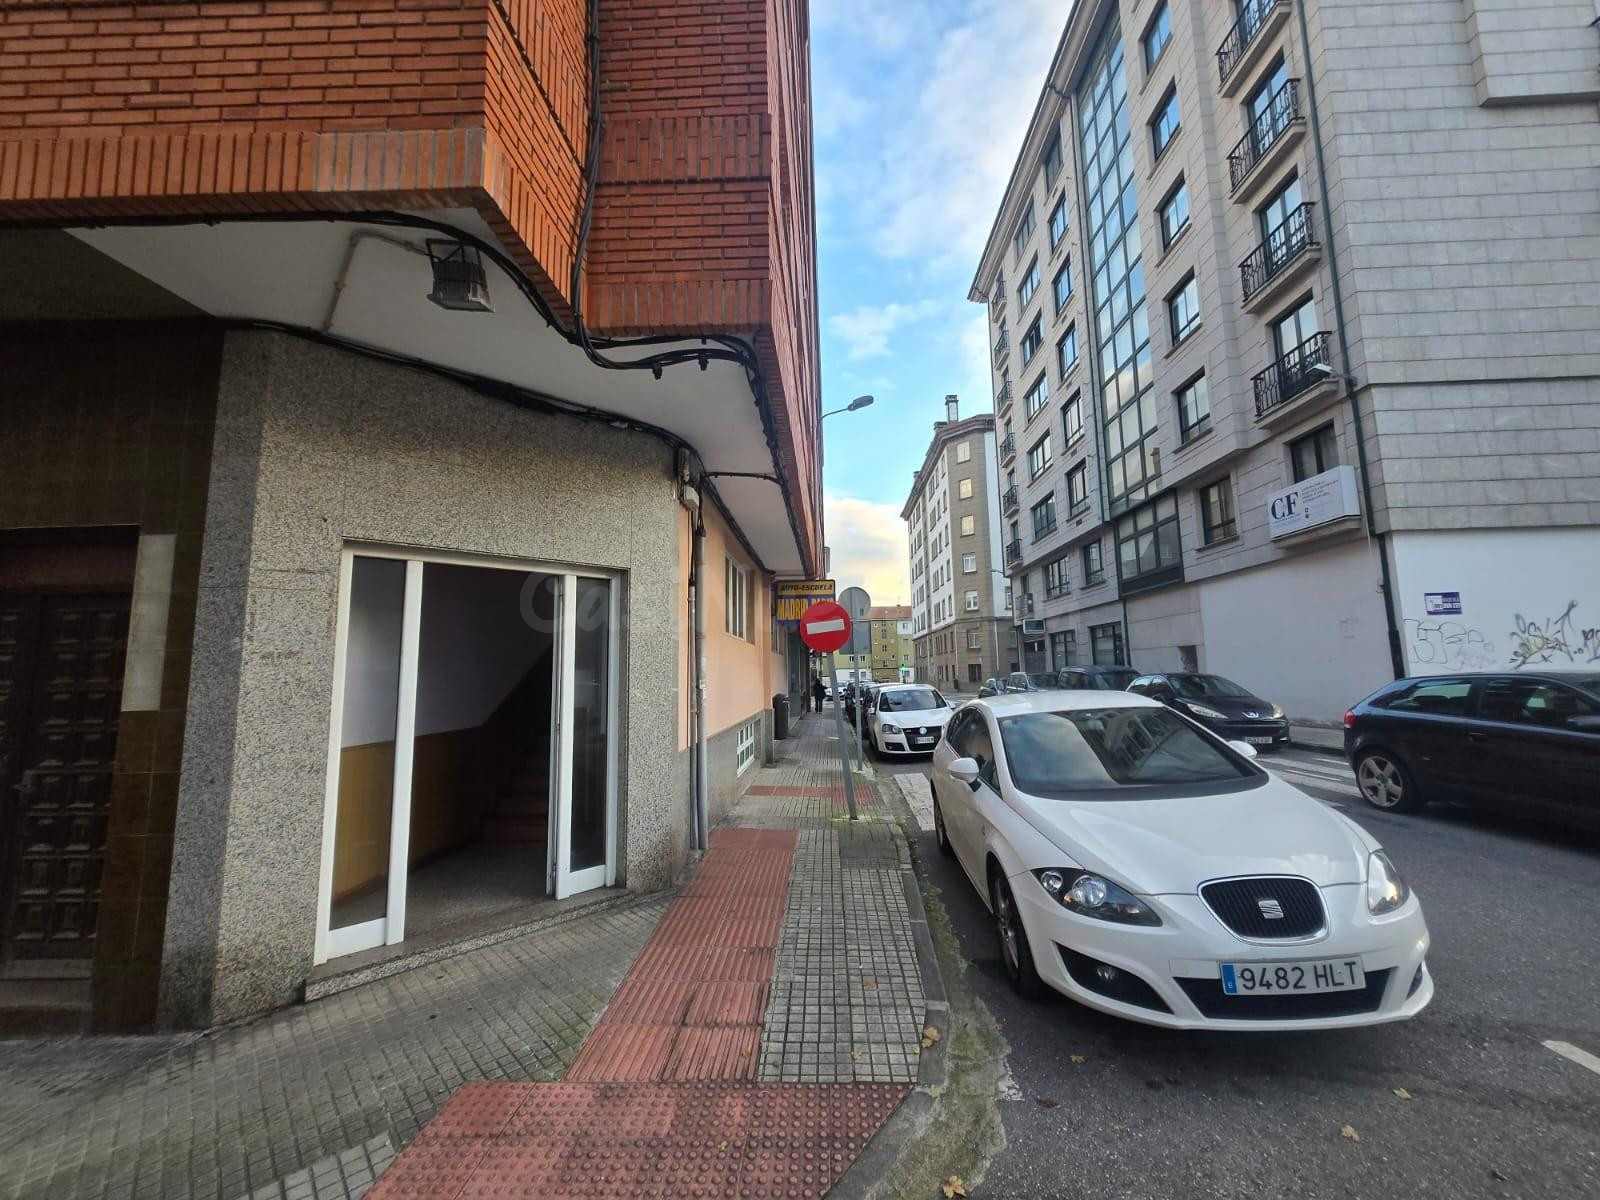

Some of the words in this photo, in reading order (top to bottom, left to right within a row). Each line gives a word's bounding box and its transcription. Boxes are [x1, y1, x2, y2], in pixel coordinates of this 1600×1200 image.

[1271, 491, 1299, 520] CF
[780, 583, 833, 592] AUTO-ESCUELA
[1240, 967, 1306, 990] 9482
[1313, 961, 1357, 988] HLT
